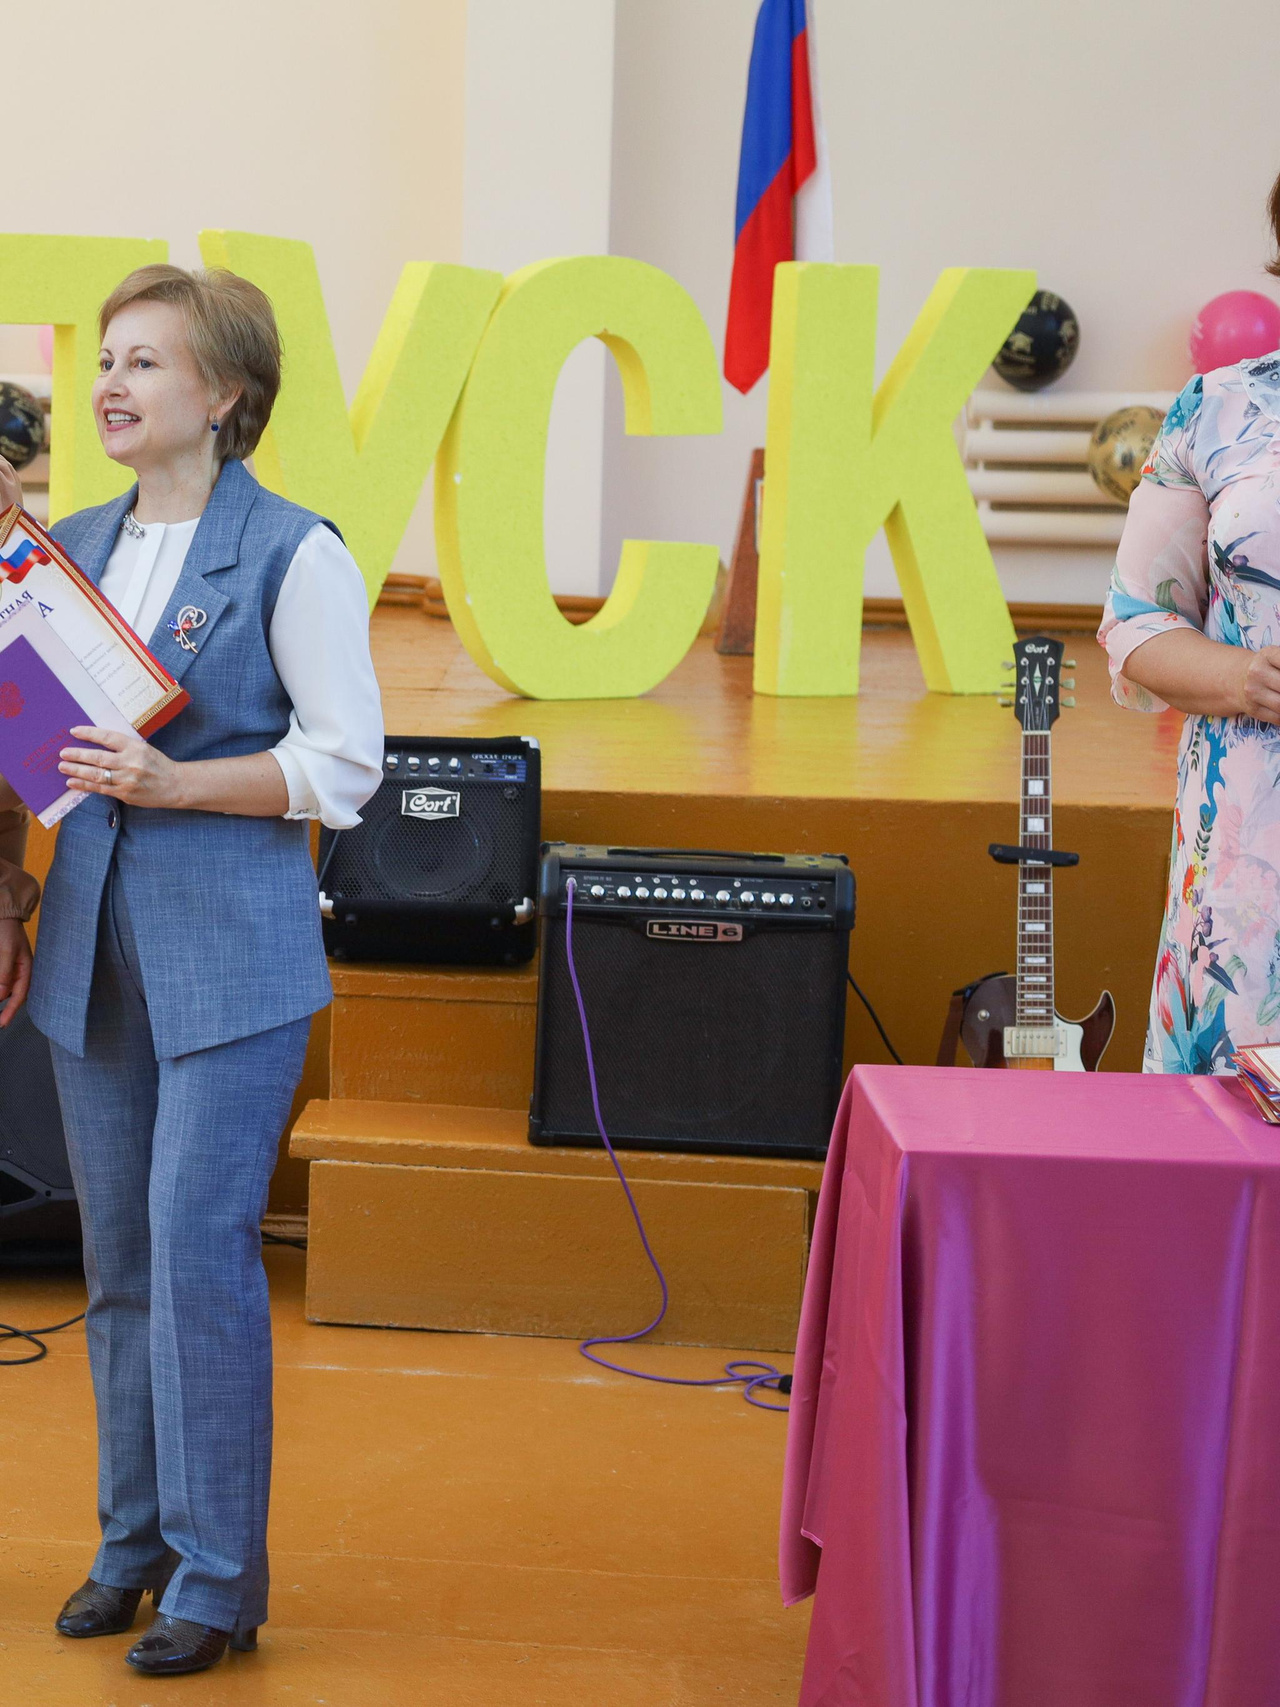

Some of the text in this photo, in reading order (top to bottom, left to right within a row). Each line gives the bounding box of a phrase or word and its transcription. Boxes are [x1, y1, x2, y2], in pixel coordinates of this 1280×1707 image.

[1025, 643, 1049, 653] Cort
[409, 795, 452, 812] Cort
[652, 924, 738, 936] LINE 6
